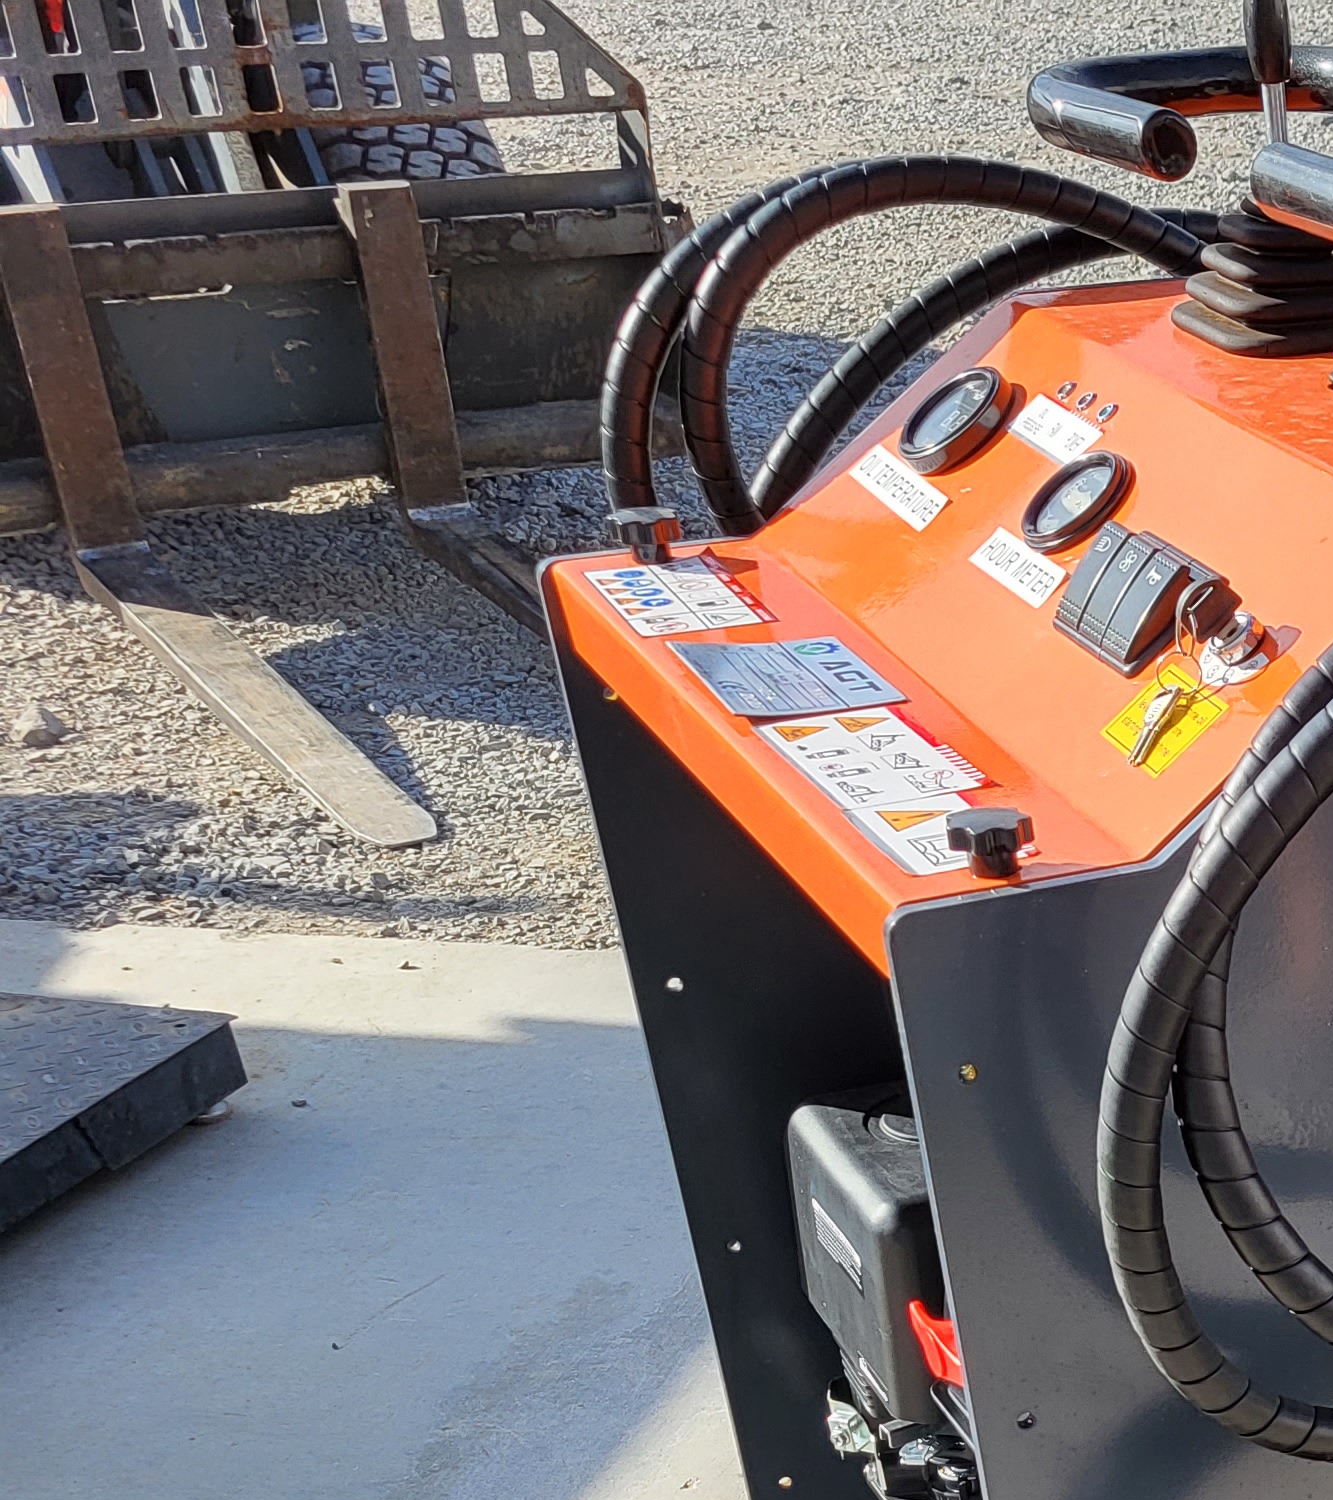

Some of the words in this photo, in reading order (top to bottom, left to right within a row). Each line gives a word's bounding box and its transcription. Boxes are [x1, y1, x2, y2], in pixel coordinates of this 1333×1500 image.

[859, 454, 881, 477] OIL
[873, 464, 940, 523] TEMPERATURE
[979, 538, 1019, 572] HOUR
[1010, 558, 1055, 597] METER
[818, 661, 883, 692] AGT
